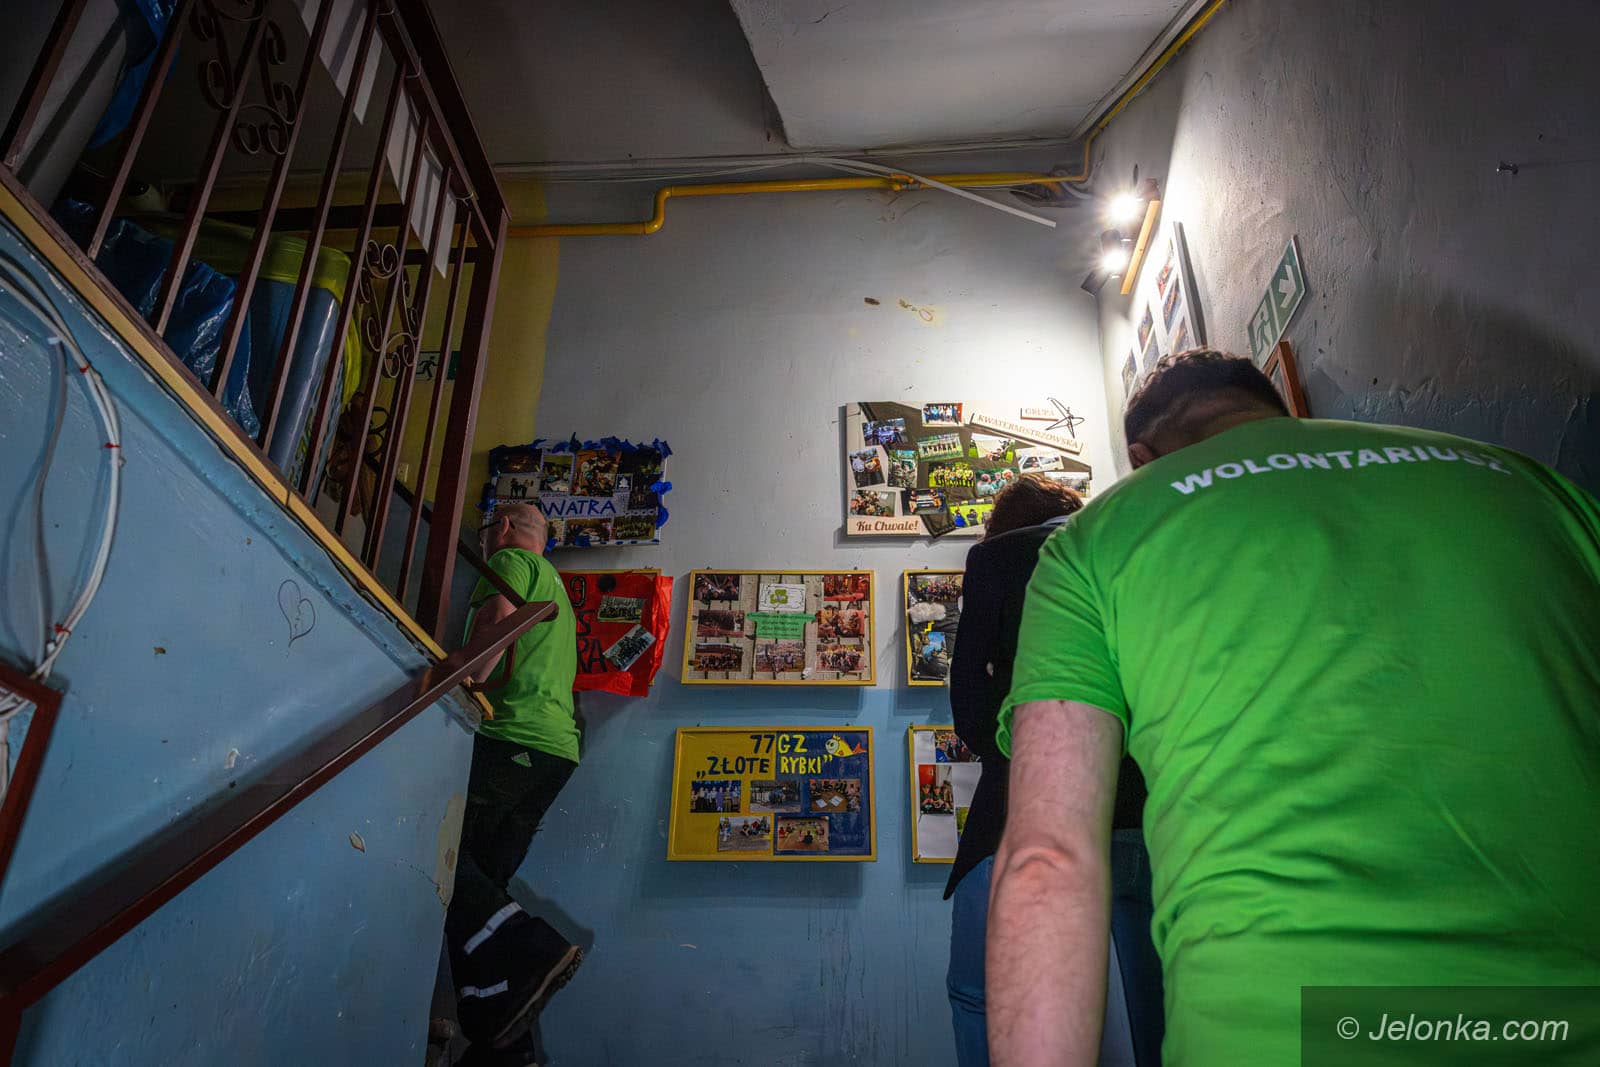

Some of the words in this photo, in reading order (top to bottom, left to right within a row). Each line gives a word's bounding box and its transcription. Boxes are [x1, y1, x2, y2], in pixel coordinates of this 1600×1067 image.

[1171, 445, 1512, 495] WOLONTARIUSZ
[540, 498, 617, 517] WATRA
[856, 520, 872, 532] Ku
[874, 519, 919, 532] Chwale!
